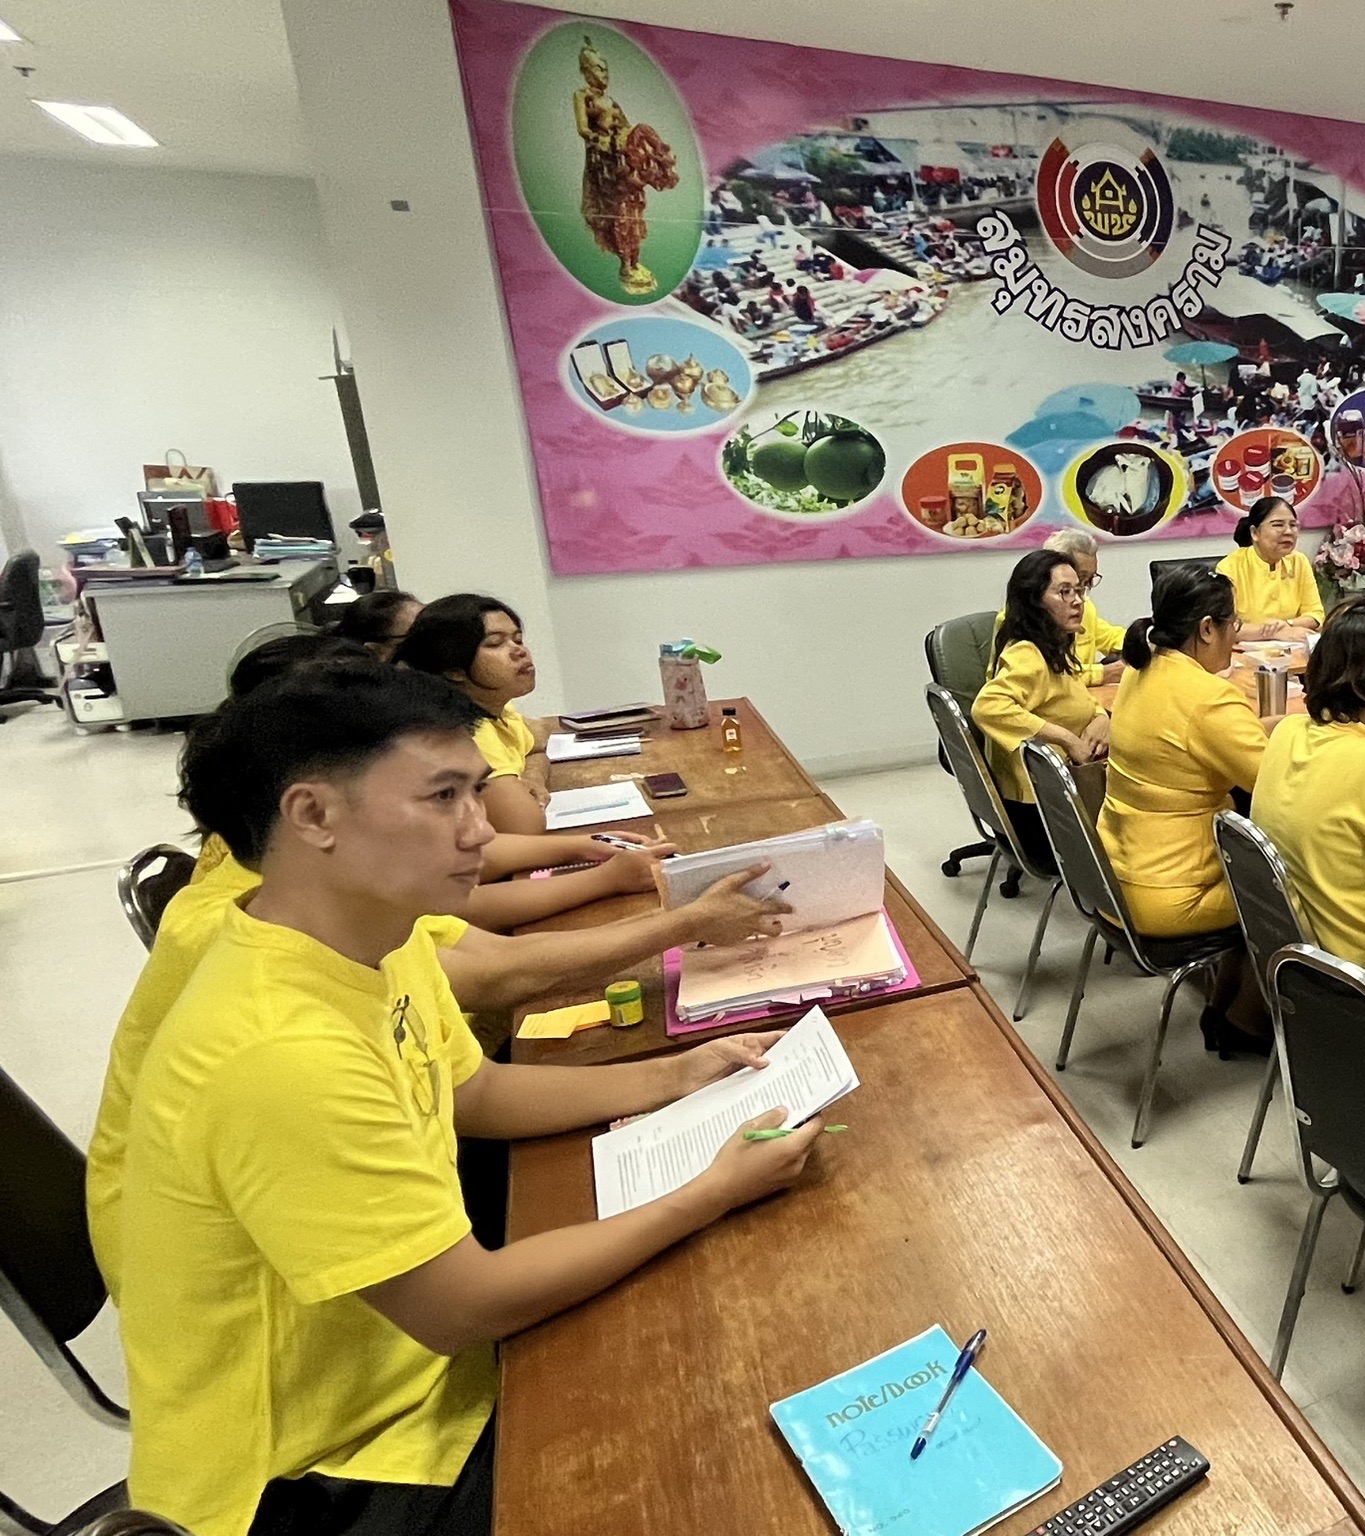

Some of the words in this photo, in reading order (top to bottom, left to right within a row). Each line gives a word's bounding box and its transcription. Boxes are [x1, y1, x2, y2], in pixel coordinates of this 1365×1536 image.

[976, 208, 1232, 350] สมุทรสงคราม
